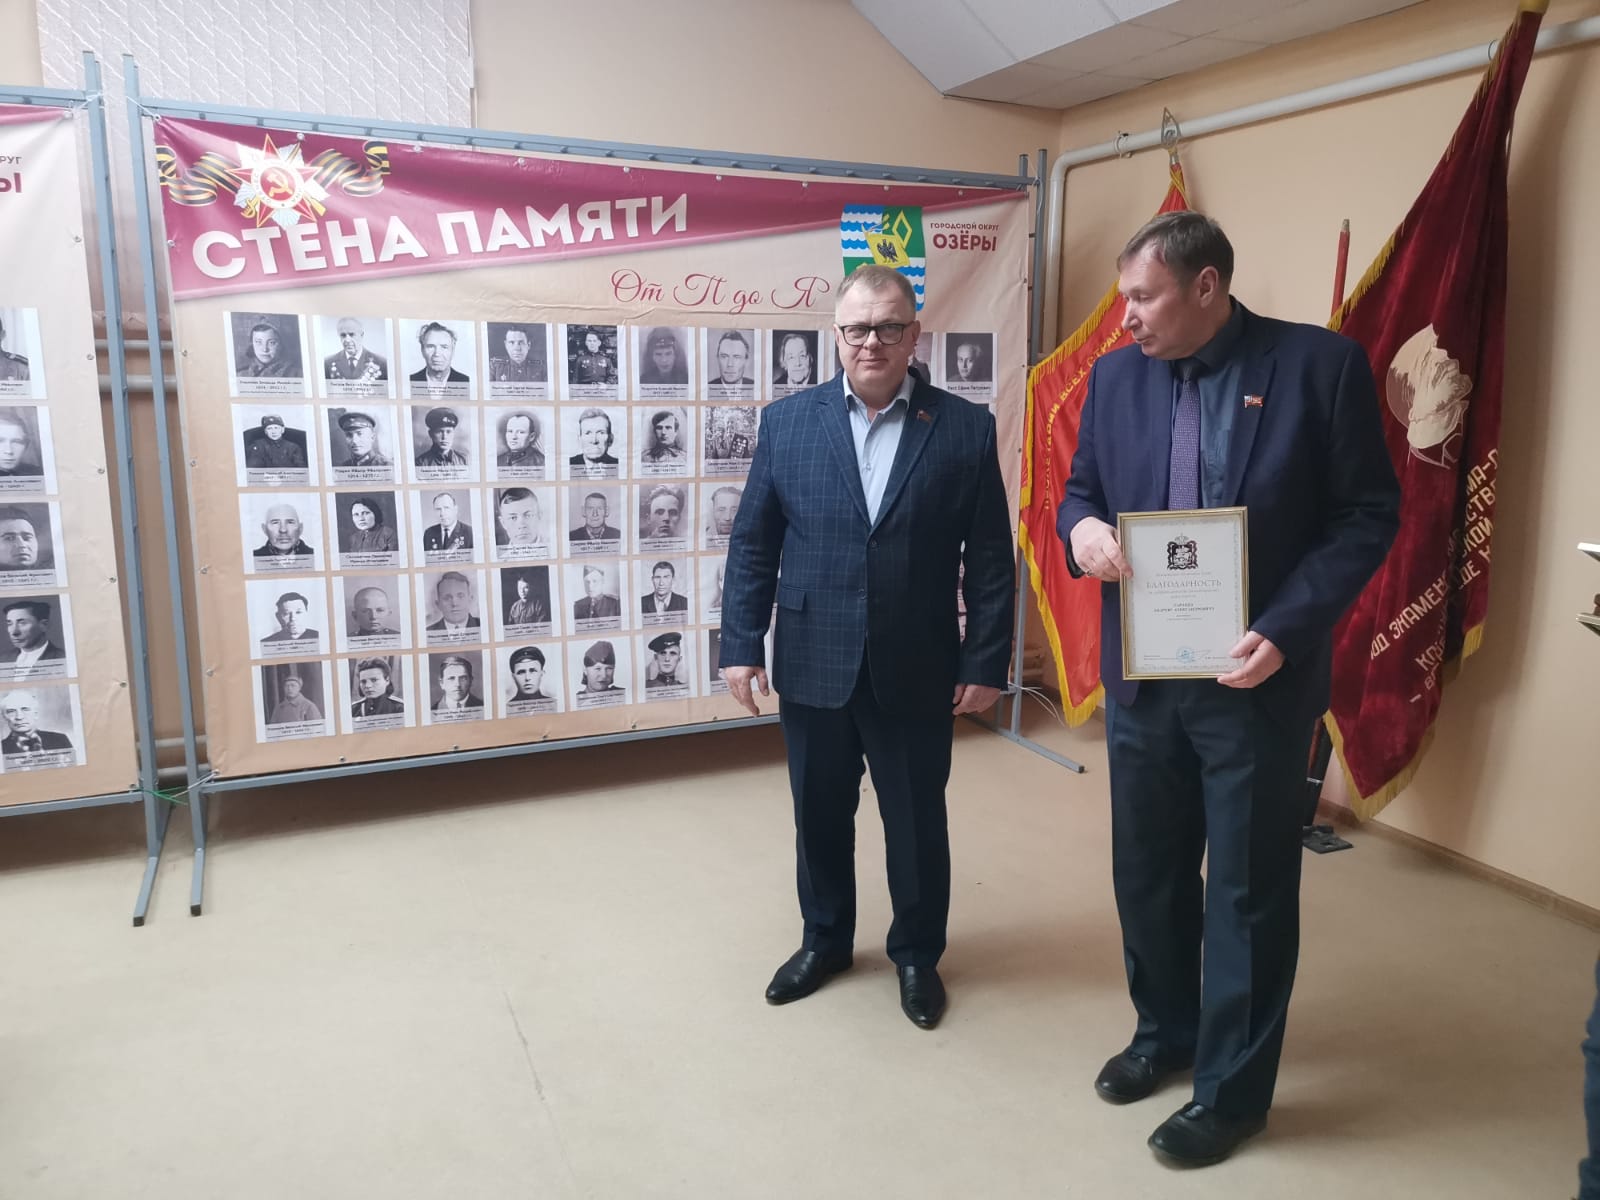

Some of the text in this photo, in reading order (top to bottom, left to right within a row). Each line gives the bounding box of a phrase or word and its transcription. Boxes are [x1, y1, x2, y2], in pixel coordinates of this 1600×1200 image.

[0, 155, 22, 165] РУГ
[191, 193, 689, 280] СТЕНА ПАМЯТИ
[930, 222, 1000, 231] ГОРОДСКОЙ ОКРУГ
[932, 230, 997, 251] ОЗЁРЫ
[611, 268, 830, 314] От П до Я
[1388, 577, 1449, 640] ЗНАМЕН
